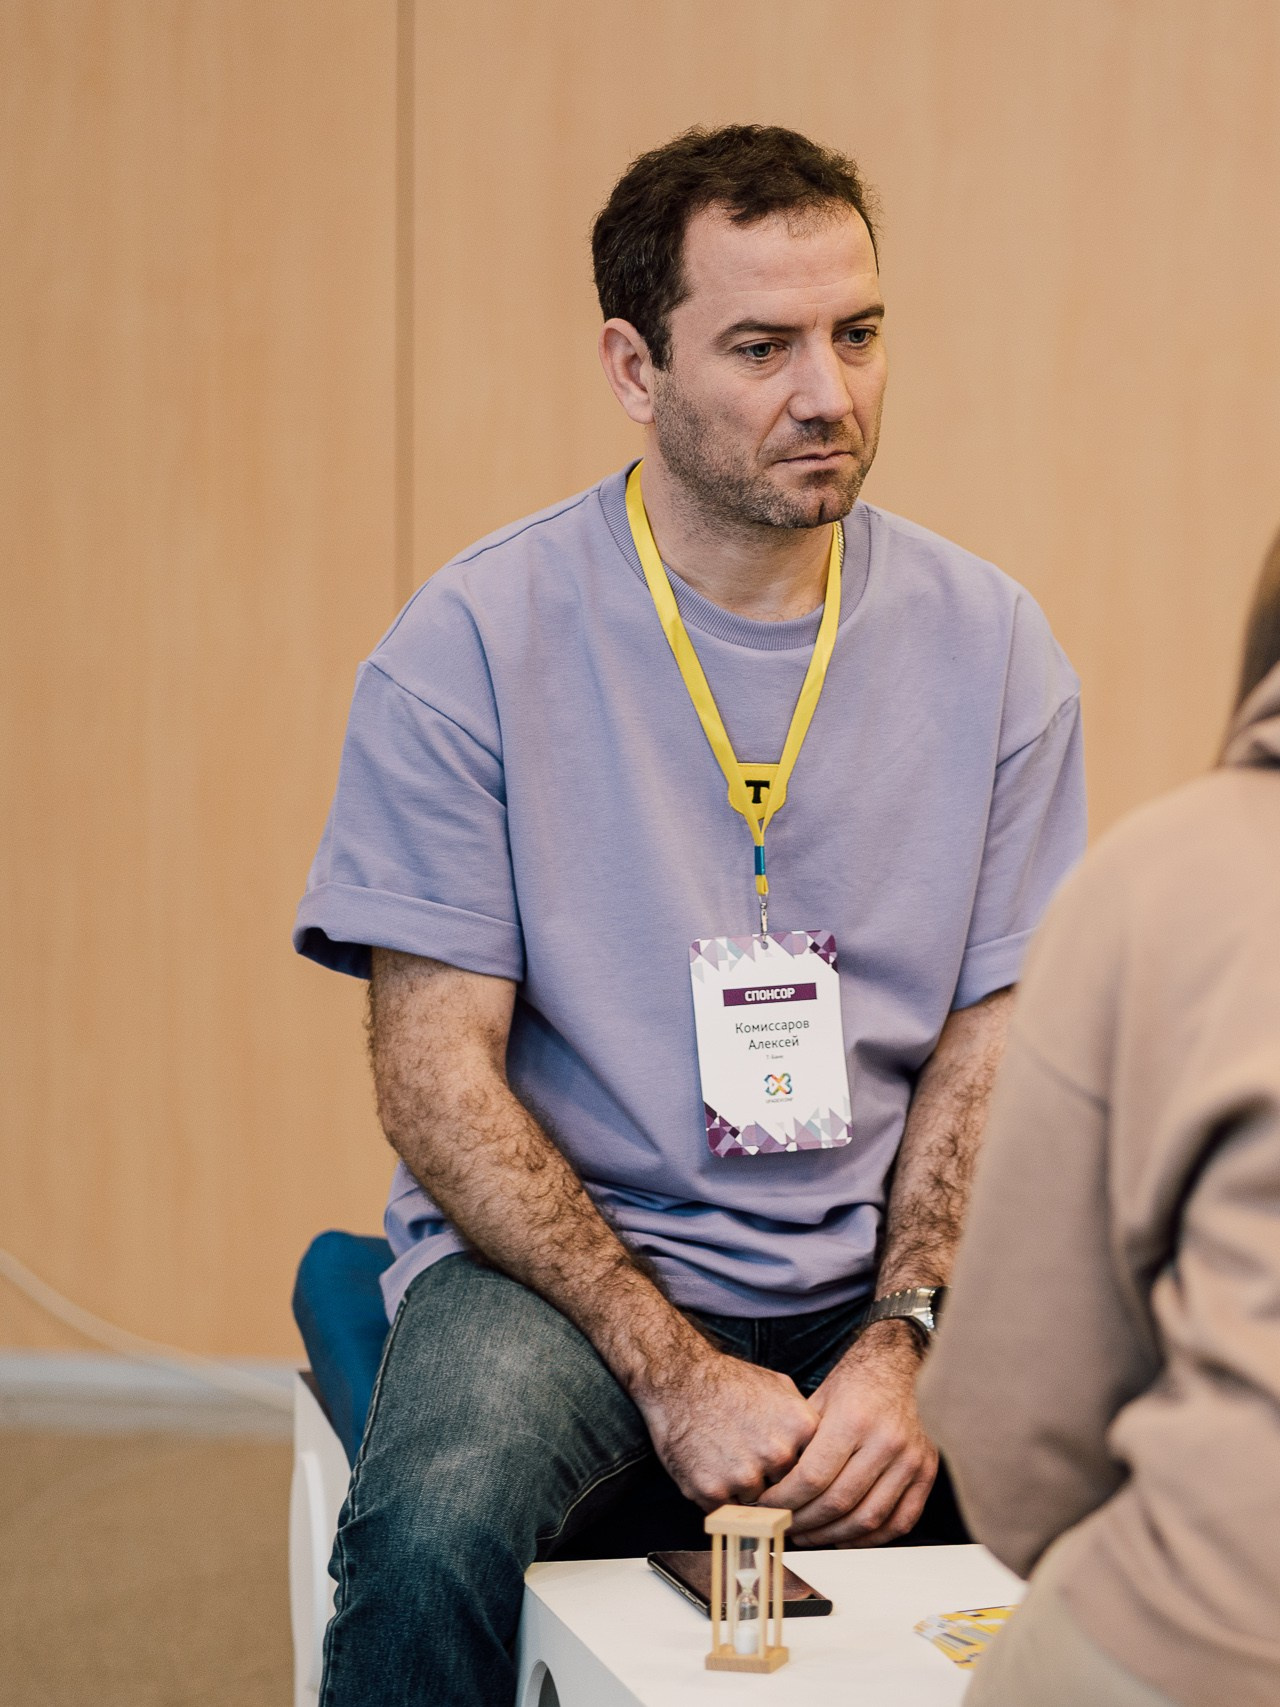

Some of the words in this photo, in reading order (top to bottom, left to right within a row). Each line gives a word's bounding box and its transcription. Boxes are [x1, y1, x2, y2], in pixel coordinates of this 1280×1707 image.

[744, 987, 796, 1002] СПОНСОР
[735, 1020, 810, 1034] Комиссаров
[748, 1035, 800, 1051] Алексей
